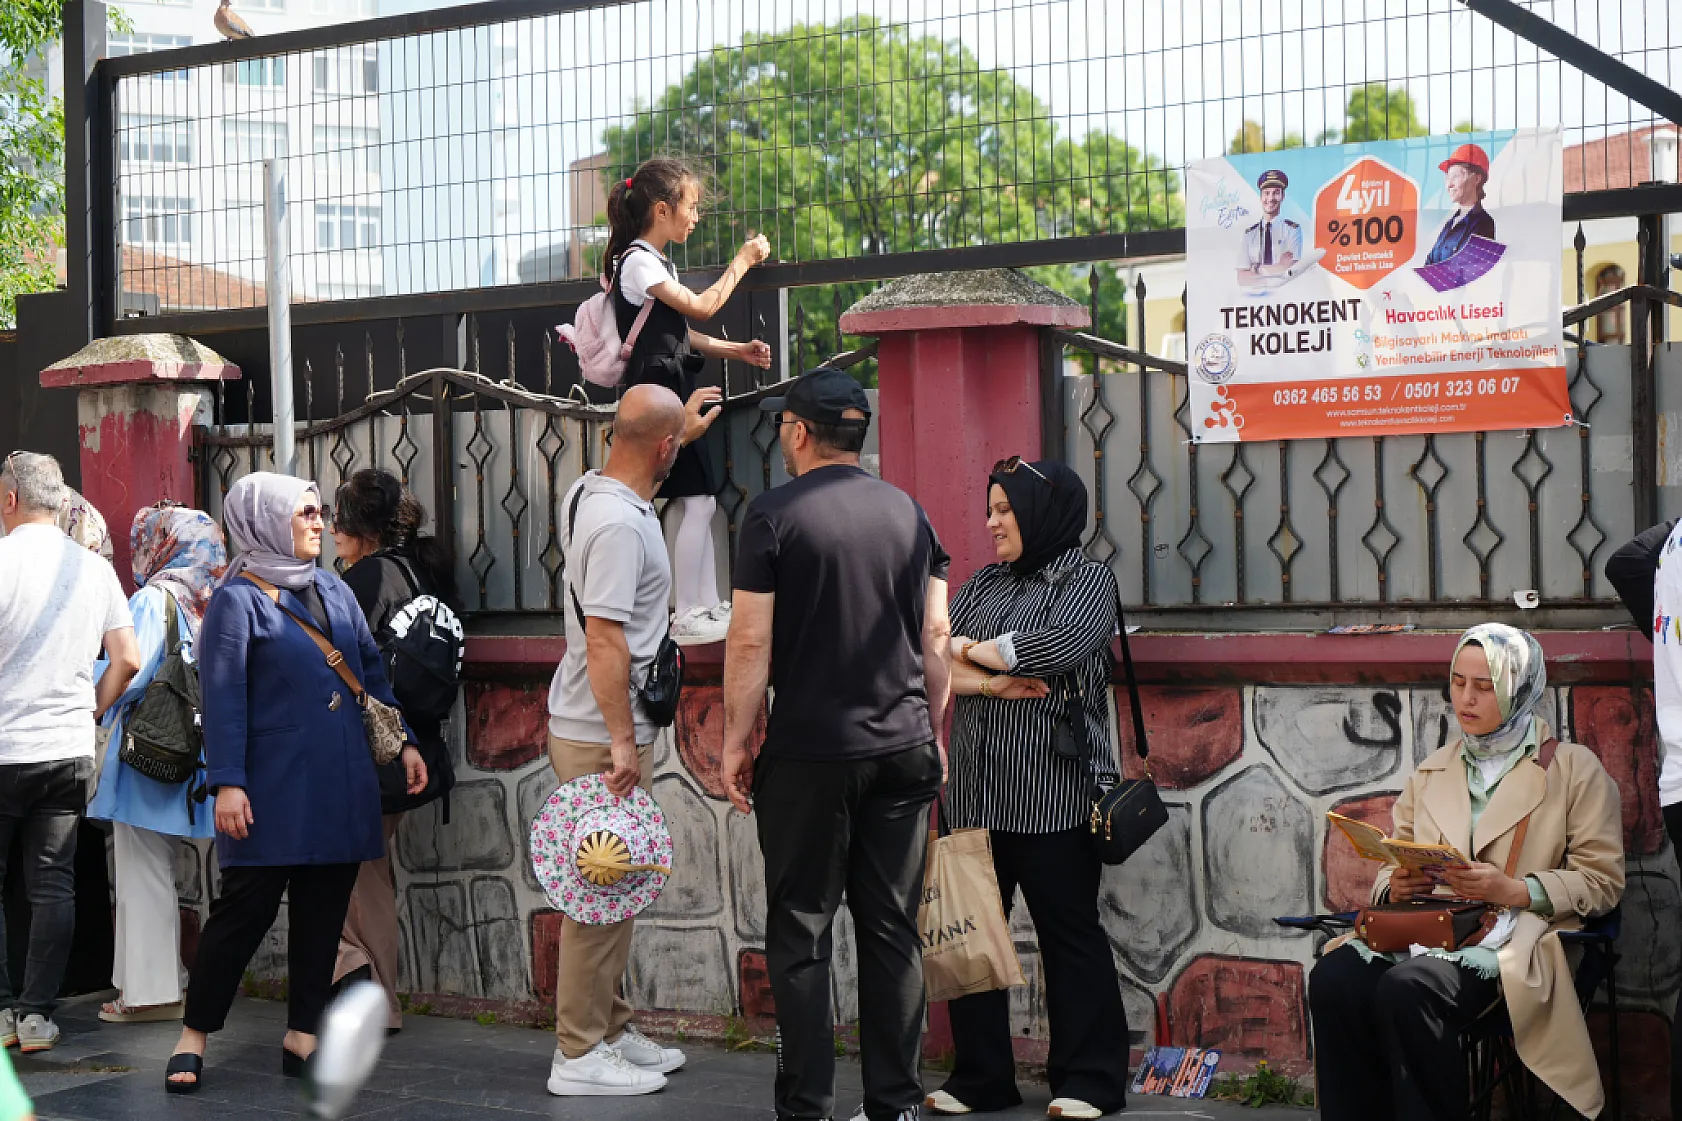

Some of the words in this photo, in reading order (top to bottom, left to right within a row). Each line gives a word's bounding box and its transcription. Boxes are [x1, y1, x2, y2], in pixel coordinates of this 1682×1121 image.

[1328, 215, 1404, 247] %100
[1220, 298, 1361, 330] TEKNOKENT
[1386, 305, 1456, 324] Havacılık
[1460, 302, 1504, 320] Lisesi
[1374, 333, 1437, 350] Bilgisayarlı
[1441, 330, 1483, 344] Makine
[1375, 350, 1447, 366] Yenilenebilir
[1450, 348, 1484, 363] Enerji
[1487, 345, 1558, 361] Teknolojileri
[1273, 388, 1307, 405] 0362
[1311, 387, 1338, 404] 465
[1342, 386, 1359, 402] 56
[1364, 384, 1382, 401] 53
[1405, 381, 1440, 399] 0501
[1445, 379, 1473, 397] 323
[1477, 378, 1497, 395] 06
[1501, 377, 1520, 393] 07
